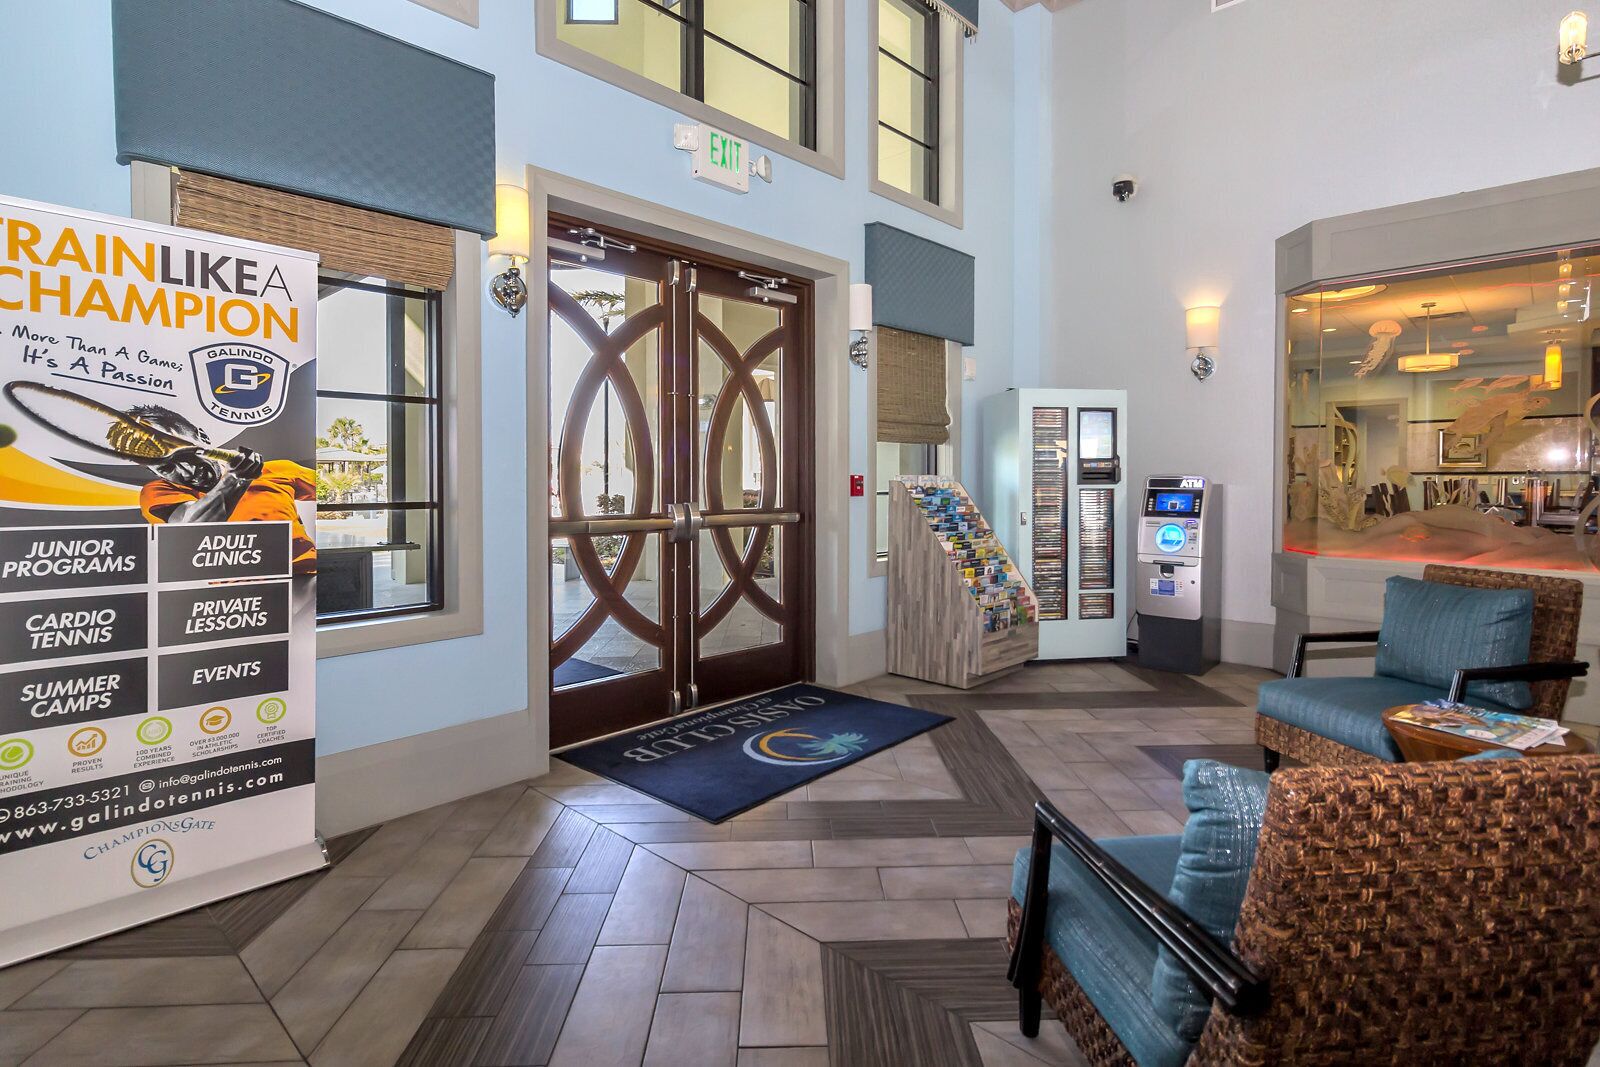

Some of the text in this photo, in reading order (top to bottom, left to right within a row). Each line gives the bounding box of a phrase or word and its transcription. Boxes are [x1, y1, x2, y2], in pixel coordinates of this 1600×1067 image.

[710, 132, 741, 173] EXIT
[0, 218, 155, 282] RAIN
[0, 266, 298, 343] CHAMPION
[12, 325, 183, 372] More Than A Game;
[207, 348, 273, 365] GALINDO
[23, 345, 173, 390] It's A Passion
[210, 402, 273, 420] TENNIS
[1180, 479, 1203, 488] ATM
[25, 539, 114, 559] JUNIOR
[198, 534, 257, 551] ADULT
[2, 556, 136, 578] PROGRAMS
[192, 550, 261, 568] CLINICS
[192, 597, 262, 617] PRIVATE
[26, 609, 116, 632] CARDIO
[185, 611, 267, 634] LESSONS
[30, 626, 112, 649] TENNIS
[192, 661, 261, 685] EVENTS
[20, 674, 121, 701] SUMMER
[30, 693, 111, 718] CAMPS
[257, 729, 285, 739] CERTIFIED
[623, 695, 826, 763] OASIS CLUB
[150, 745, 172, 754] YEARS
[189, 738, 206, 746] OVER
[205, 739, 232, 749] ATHLETIC
[258, 735, 285, 744] COACHES
[135, 752, 172, 762] COMBINED
[192, 744, 238, 757] SCHOLARSHIPS
[71, 764, 103, 774] RESULTS
[72, 757, 102, 767] PROVEN
[133, 756, 175, 768] EXPERIENCE
[14, 756, 282, 819] 863-733-5321 info@galindotennis.com
[0, 771, 284, 843] www.galindotennis.com
